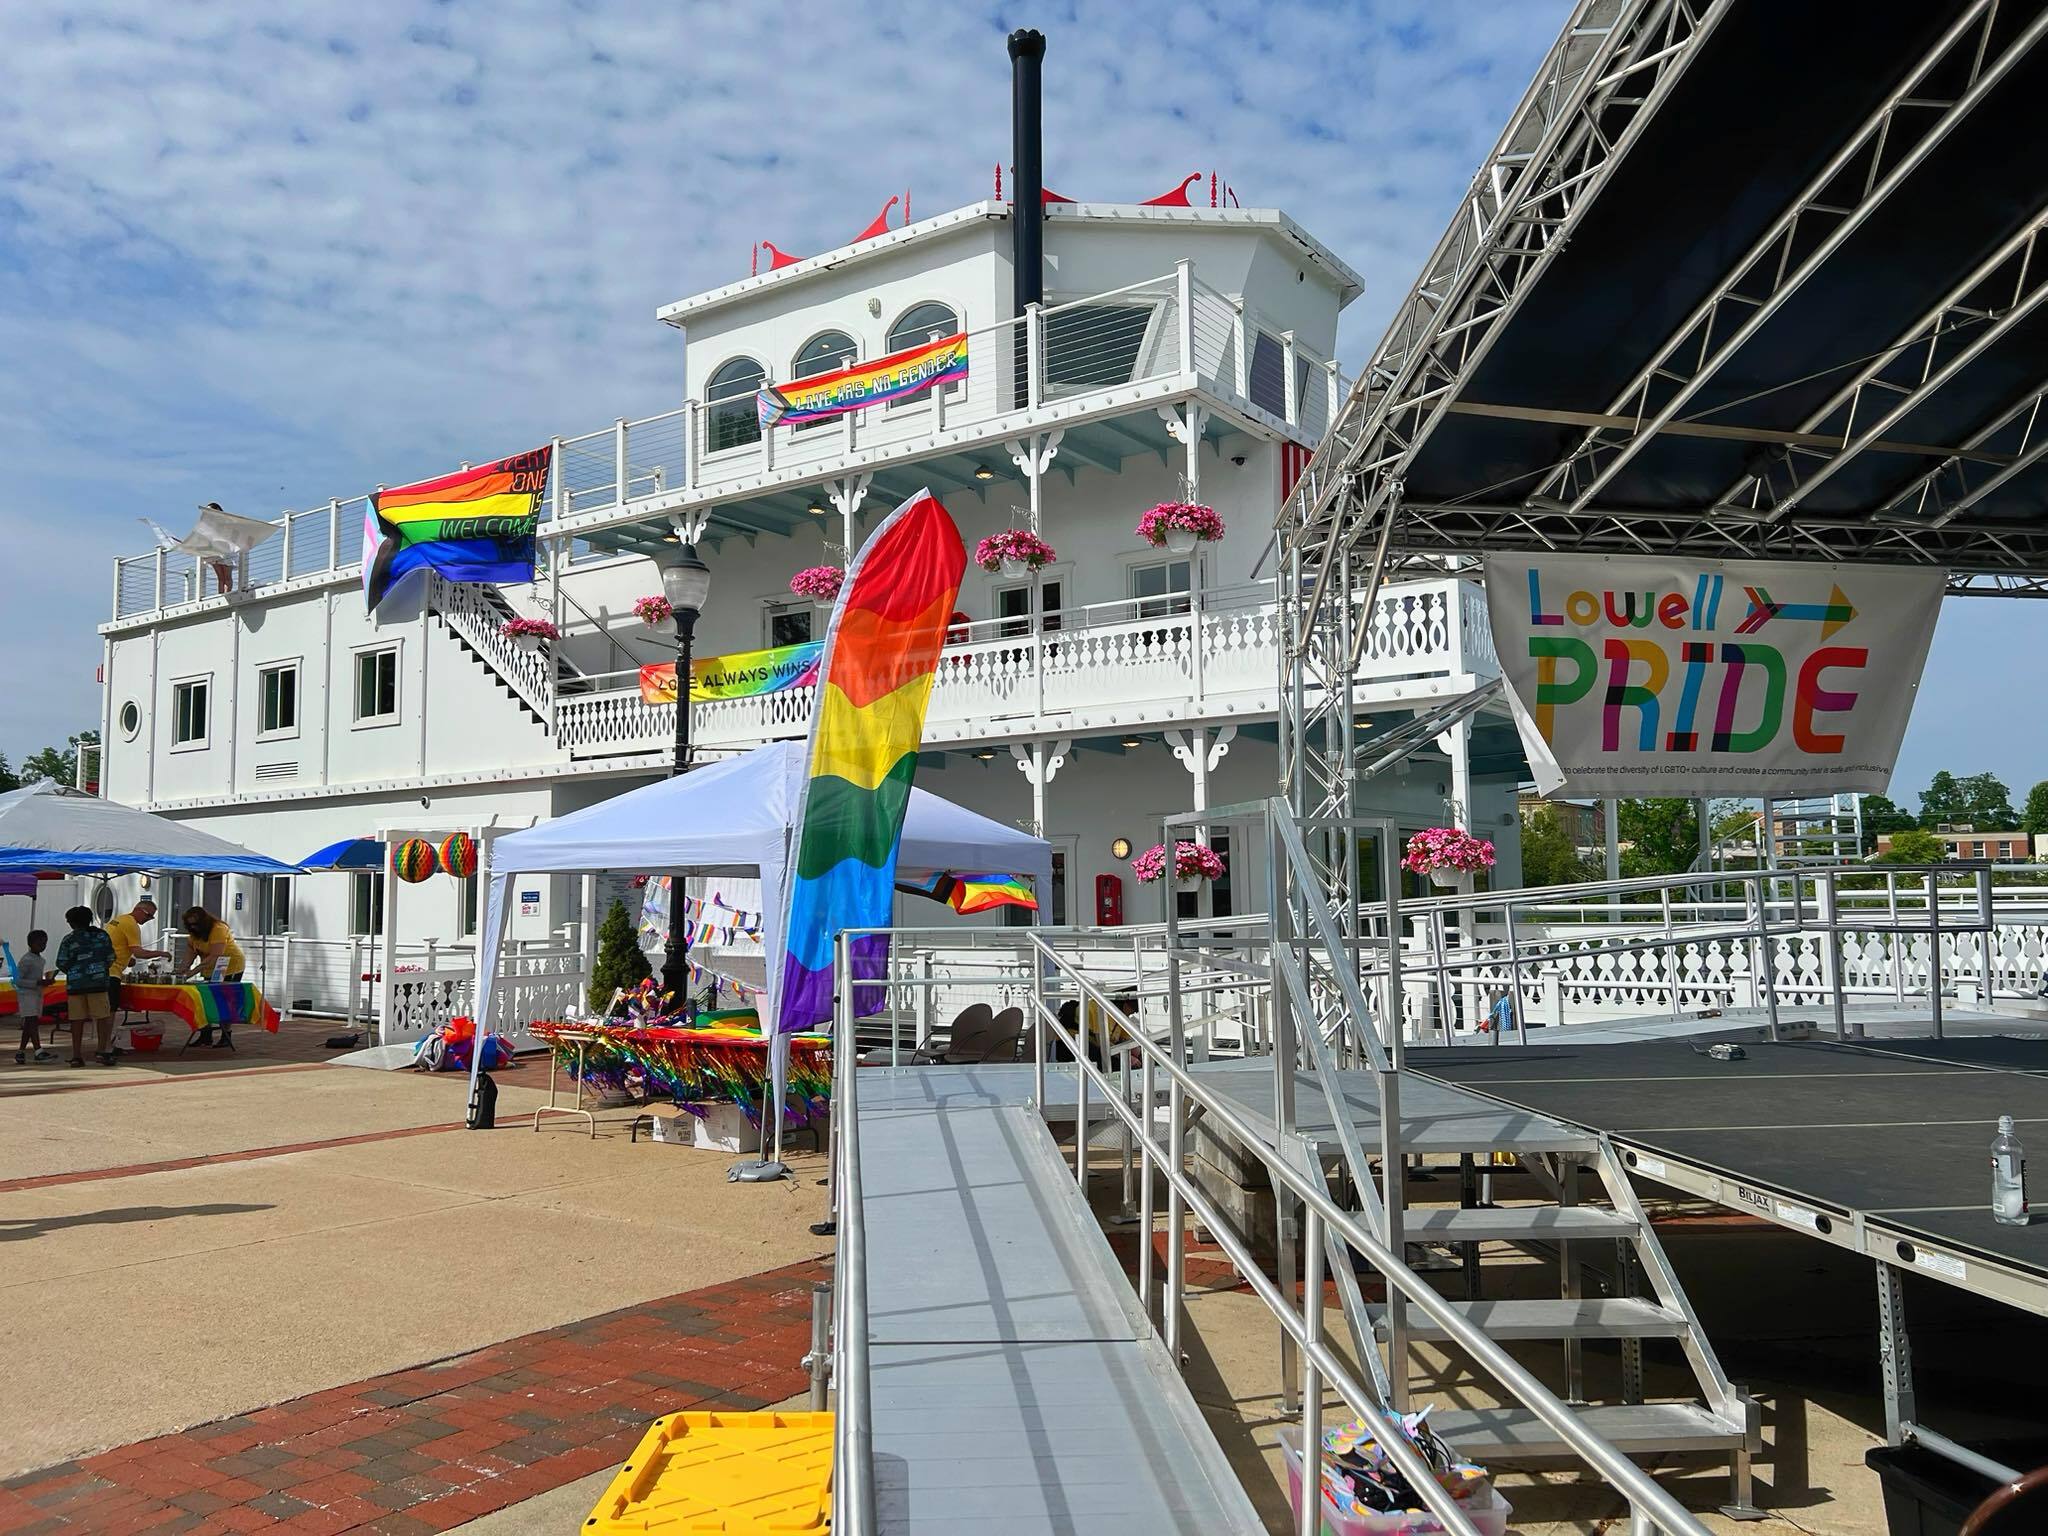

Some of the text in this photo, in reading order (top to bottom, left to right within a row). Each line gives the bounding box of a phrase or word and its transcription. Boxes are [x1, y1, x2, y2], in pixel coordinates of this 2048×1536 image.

[795, 351, 958, 412] LOVE HAS NO GENDER
[512, 466, 548, 492] ONE
[530, 491, 543, 513] IS
[440, 515, 536, 538] WELCOME
[1528, 568, 1724, 631] Lowell
[659, 659, 812, 692] LOE ALWAYS WINS
[1528, 636, 1869, 755] PRIDE
[1572, 766, 1606, 775] celebrate
[1606, 766, 1619, 774] the
[1619, 766, 1649, 776] diversity
[1651, 765, 1659, 774] of
[1660, 765, 1690, 774] LGBTQ+
[1692, 766, 1717, 774] culture
[1718, 766, 1734, 774] and
[1735, 767, 1761, 775] create
[1768, 768, 1809, 777] community
[1830, 766, 1844, 774] safe
